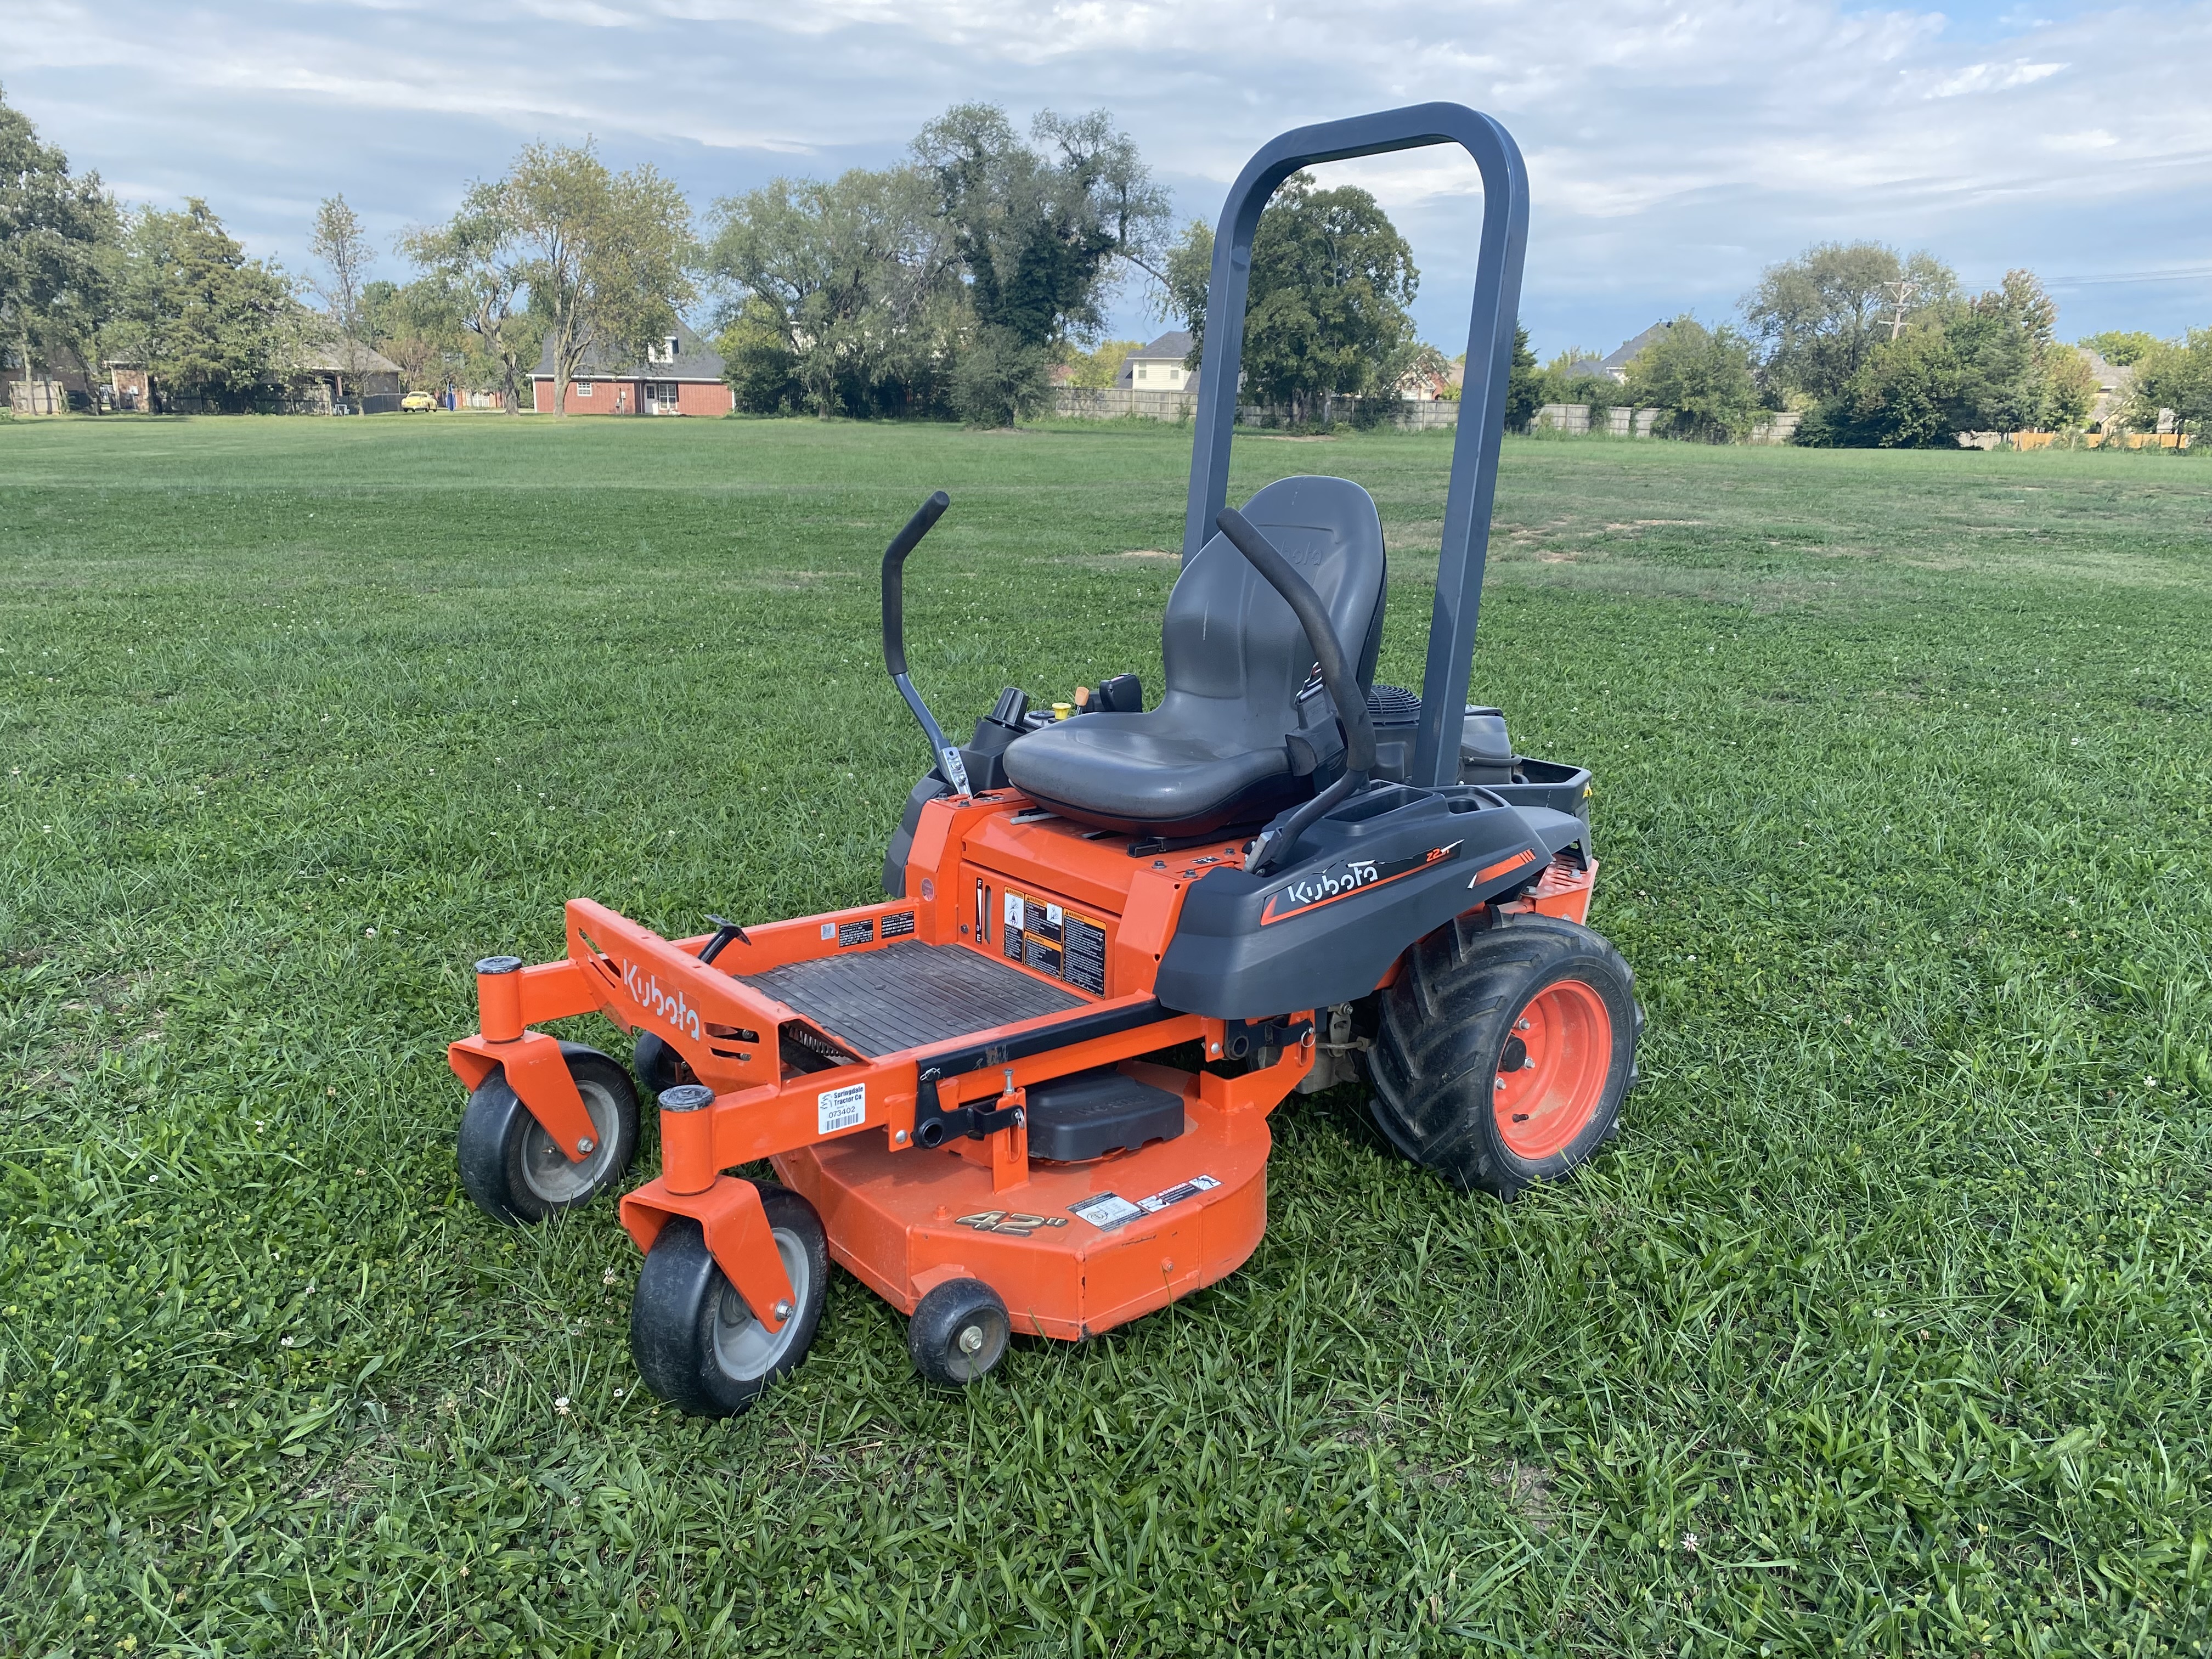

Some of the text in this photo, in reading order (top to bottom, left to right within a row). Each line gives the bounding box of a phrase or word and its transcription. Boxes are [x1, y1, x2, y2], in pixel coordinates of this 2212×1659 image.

[1279, 540, 1323, 566] bota
[1426, 848, 1449, 862] Z2
[1288, 866, 1378, 904] Kubota
[1008, 889, 1023, 899] WARNING
[1030, 896, 1045, 906] WARNING
[1069, 911, 1085, 921] WARNING
[977, 934, 981, 942] E
[1029, 934, 1044, 944] WARNING
[623, 958, 700, 1041] Kubota
[834, 1086, 864, 1098] Springdale
[834, 1096, 854, 1106] Tractor
[829, 1106, 855, 1118] 073402
[1163, 1182, 1188, 1193] DANGER
